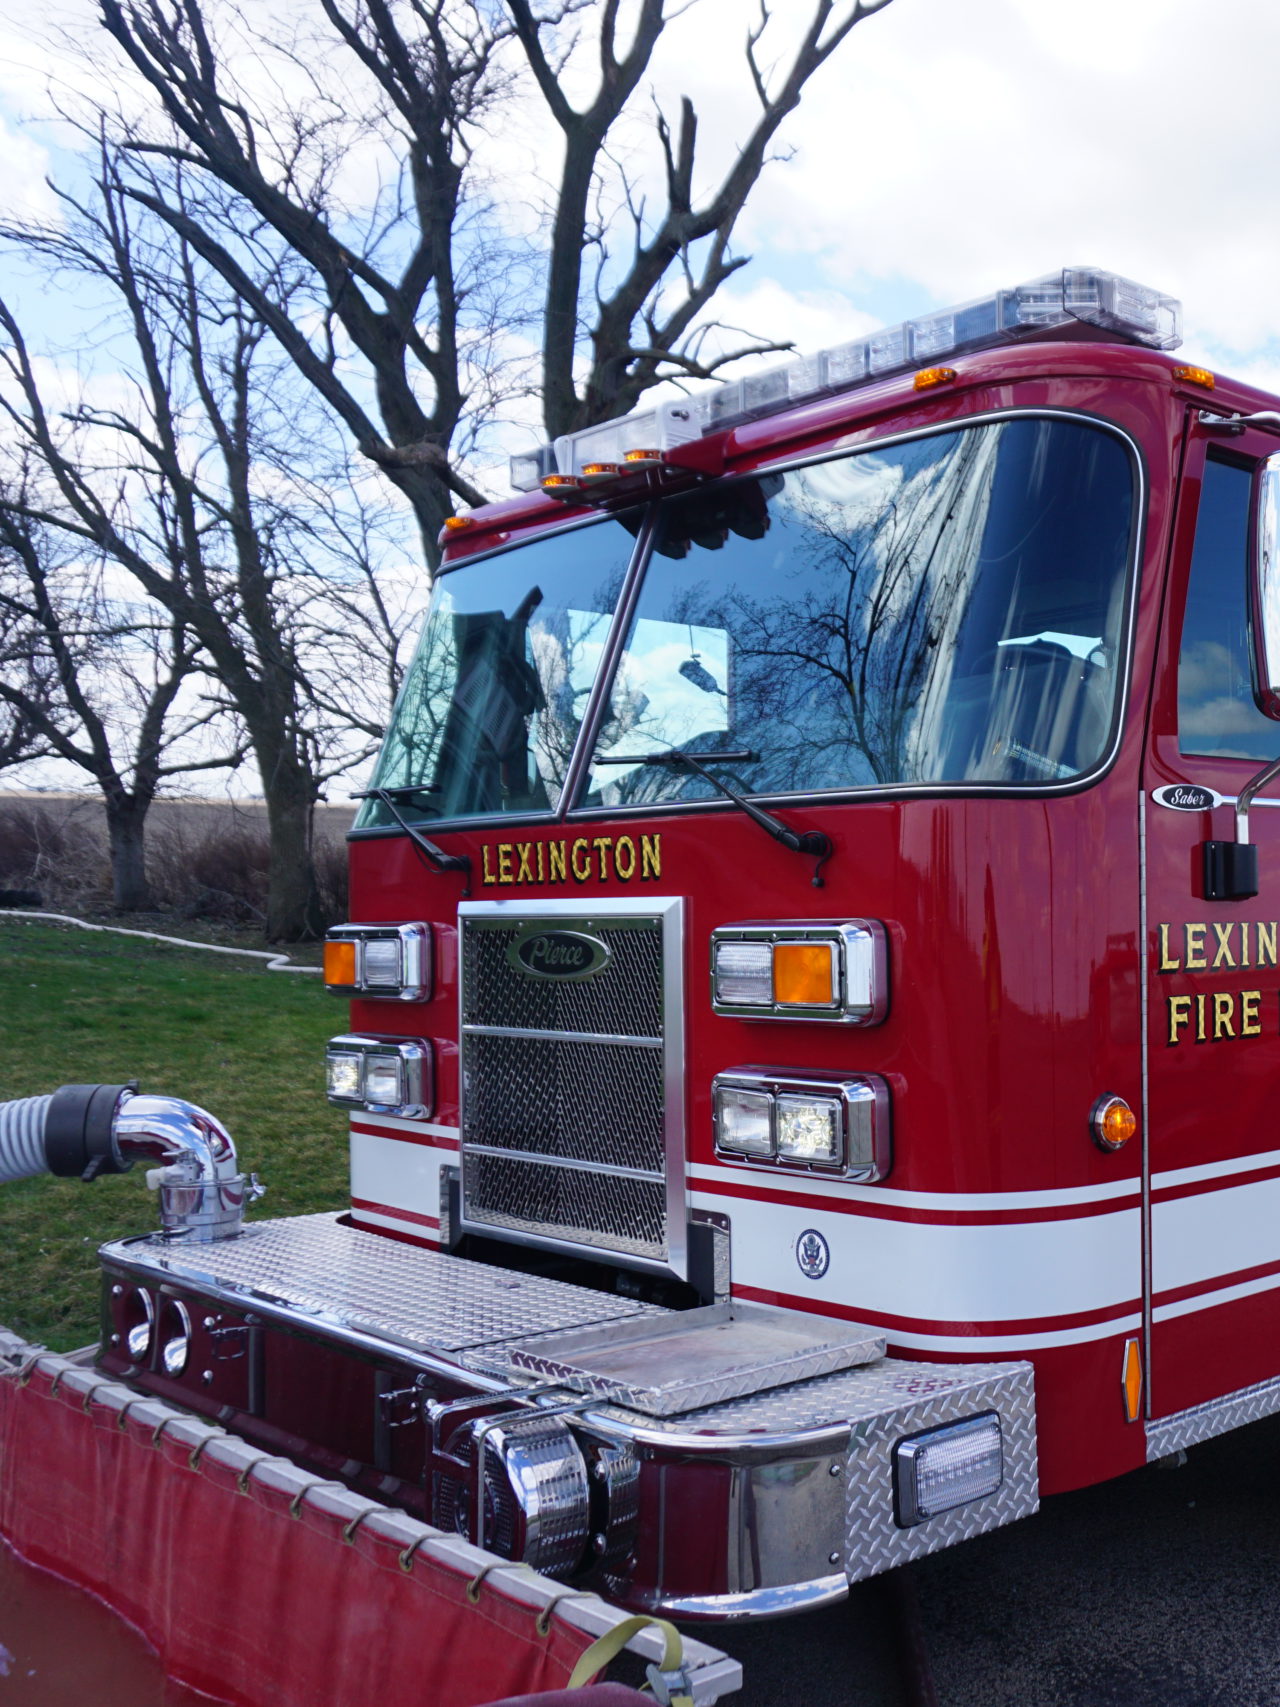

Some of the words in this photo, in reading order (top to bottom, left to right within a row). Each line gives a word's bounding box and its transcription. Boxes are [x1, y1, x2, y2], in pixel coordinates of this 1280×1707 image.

[1170, 787, 1206, 805] Saber
[481, 833, 662, 885] LEXINGTON
[529, 936, 585, 969] Pierce
[1167, 990, 1262, 1046] FIRE
